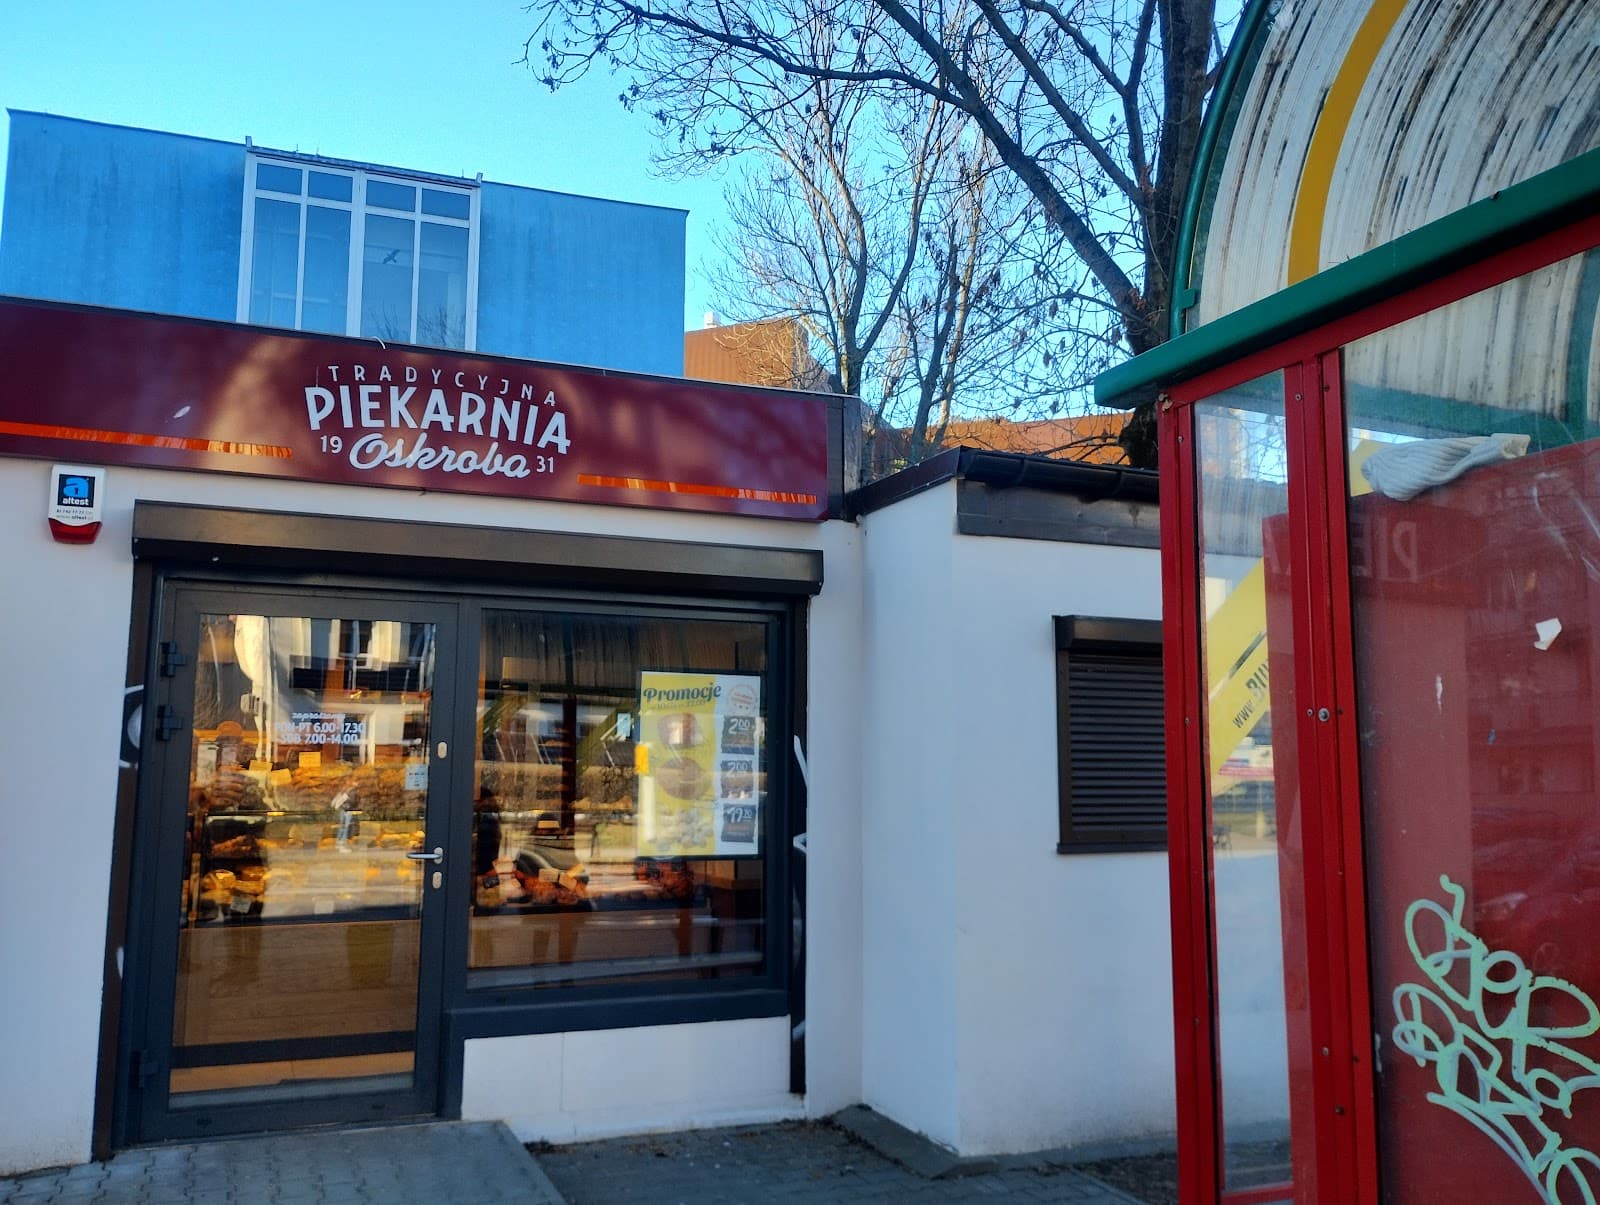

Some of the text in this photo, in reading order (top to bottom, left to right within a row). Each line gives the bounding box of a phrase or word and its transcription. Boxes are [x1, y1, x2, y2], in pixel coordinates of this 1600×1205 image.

[328, 365, 555, 406] TRADYCYJNA
[304, 384, 571, 454] PIEKARNIA
[320, 432, 554, 479] 19 Oskroba 31
[62, 497, 89, 505] altest
[643, 682, 722, 702] Promocje
